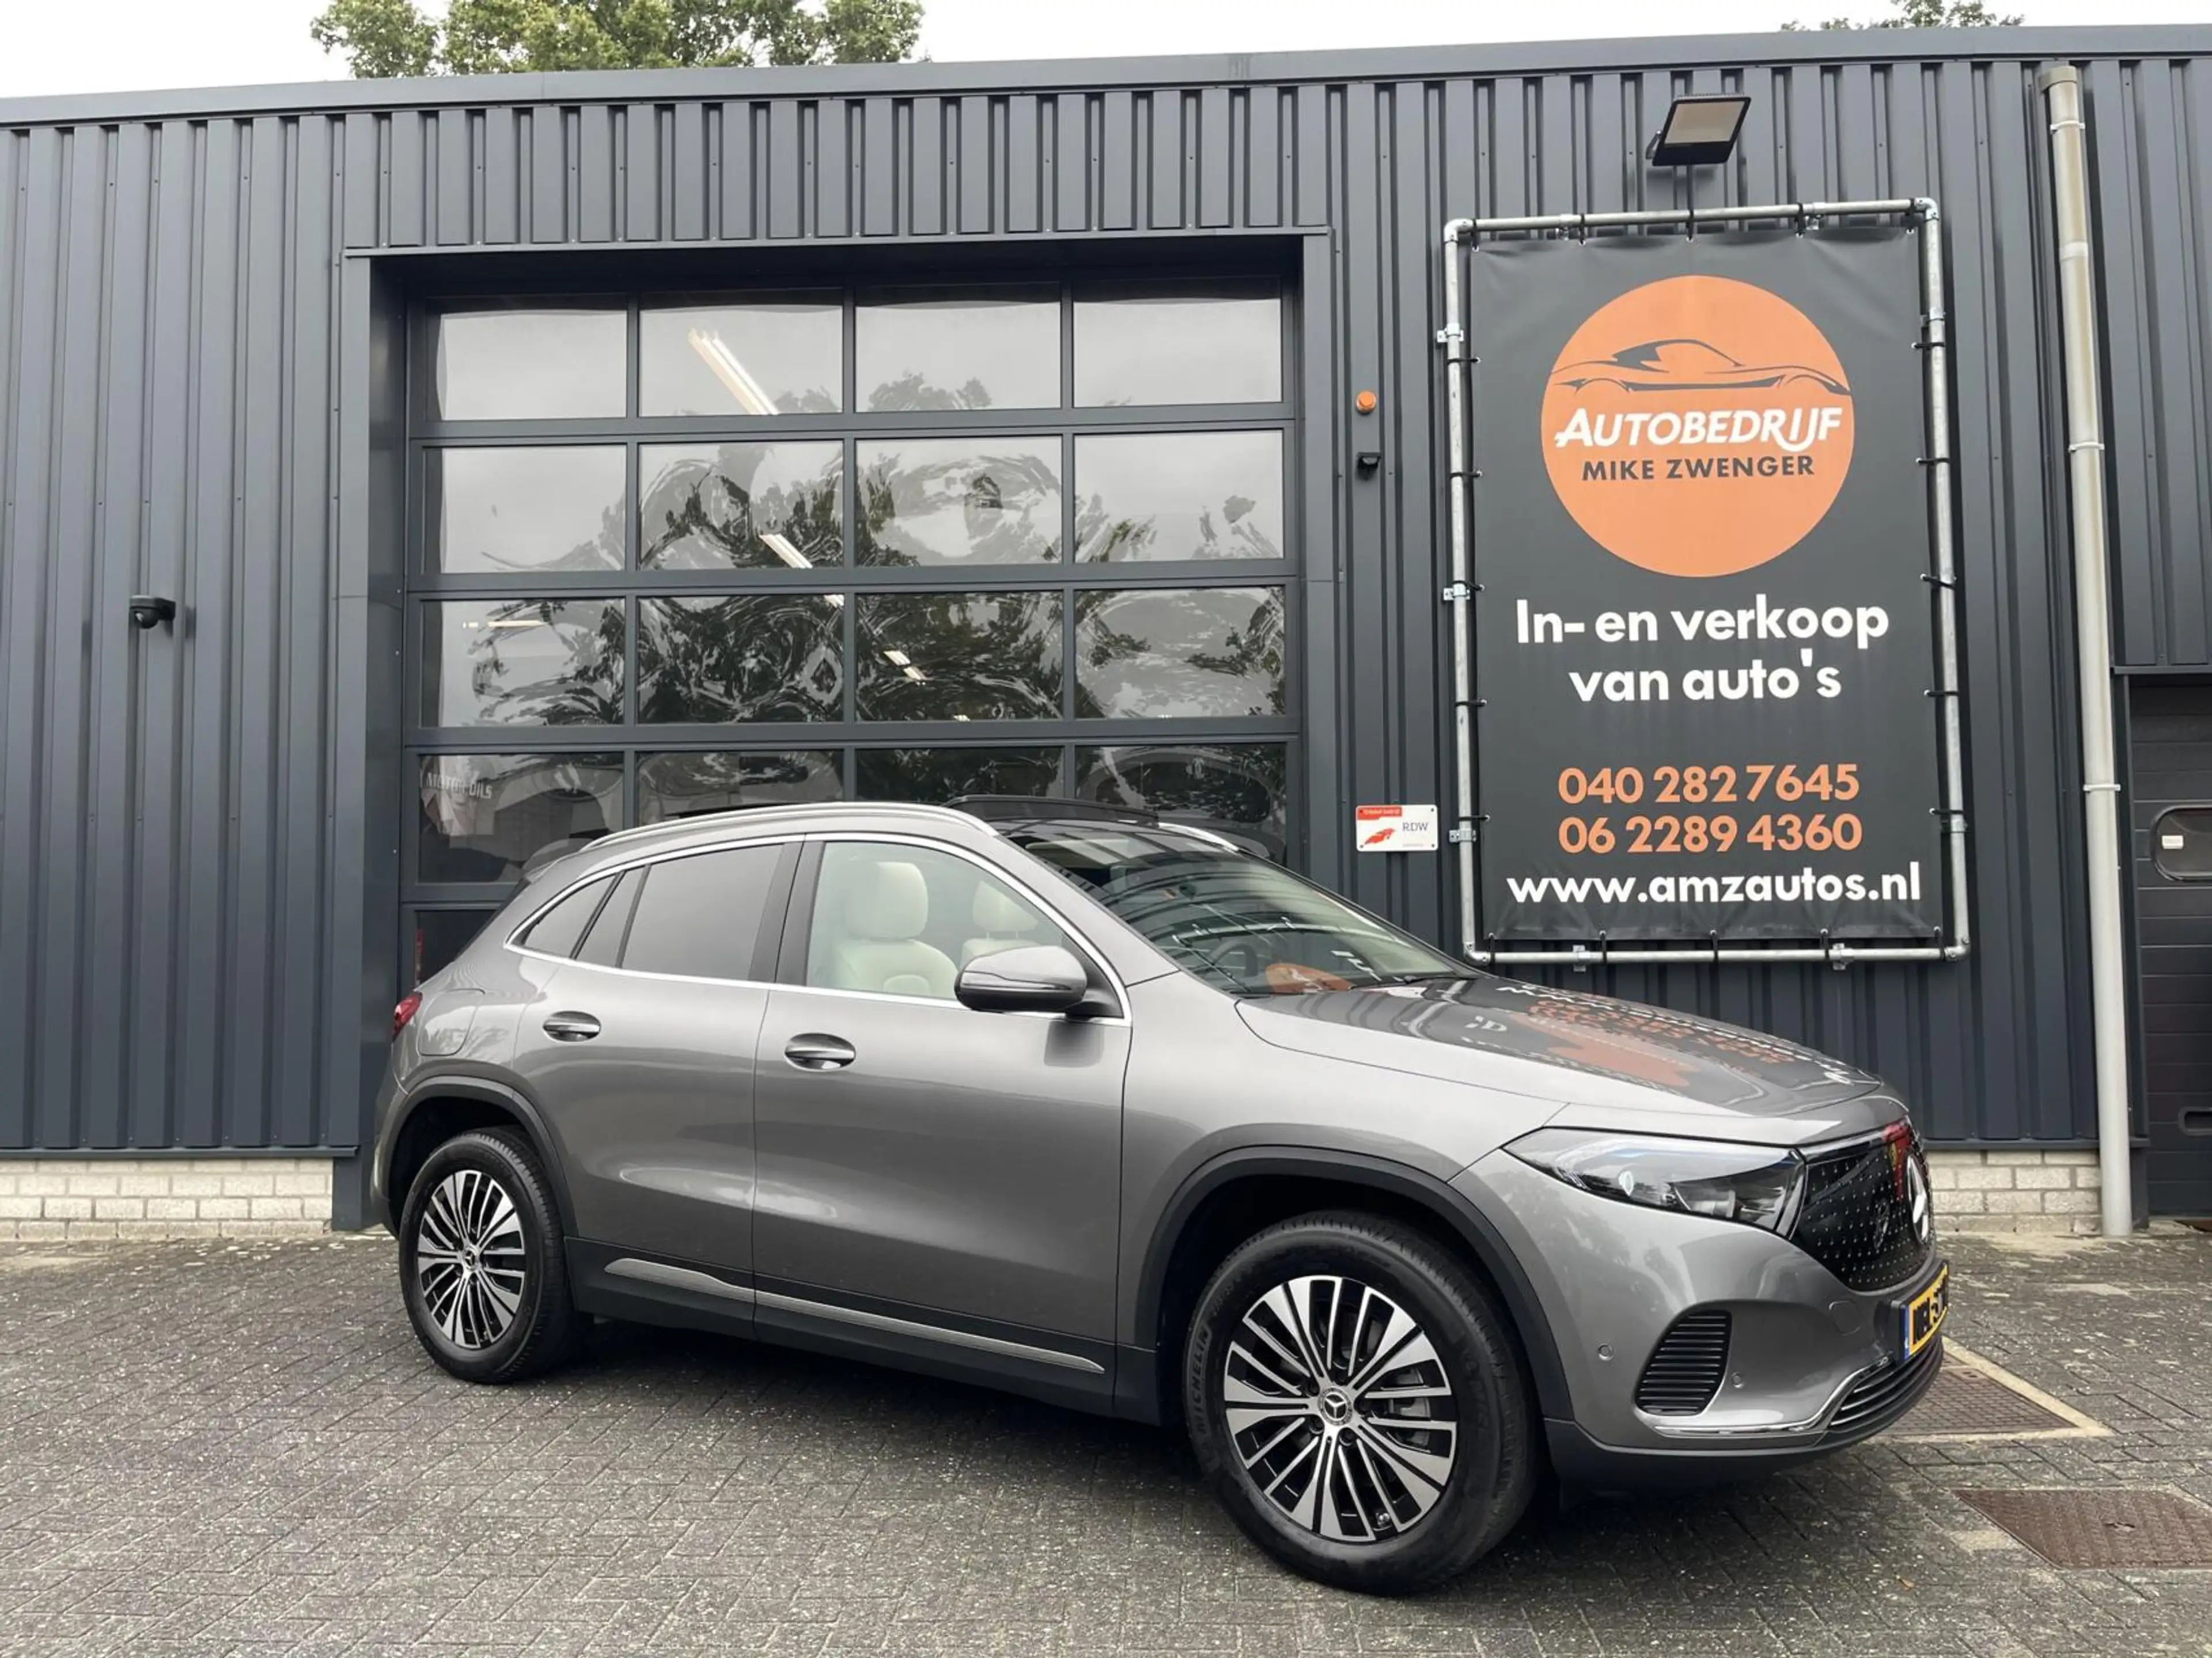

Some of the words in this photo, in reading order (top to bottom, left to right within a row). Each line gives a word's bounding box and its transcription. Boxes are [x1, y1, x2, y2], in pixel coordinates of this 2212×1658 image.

[1554, 407, 1843, 453] AUTOBEDRIJF
[1582, 460, 1654, 481] MIKE
[1666, 455, 1815, 479] ZWENGER
[1517, 599, 1585, 644] In-
[1595, 610, 1658, 643] en
[1670, 593, 1889, 650] verkoop
[1569, 670, 1669, 702] van
[1682, 648, 1842, 701] auto's
[1558, 766, 1645, 805] 040
[1653, 765, 1738, 803] 282
[1745, 763, 1860, 802] 7645
[1402, 822, 1429, 832] RDW
[1558, 816, 1616, 855] 06
[1626, 814, 1738, 853] 2289
[1745, 813, 1863, 852] 4360
[1506, 861, 1921, 904] www.amzautos.nl
[1191, 1325, 1211, 1435] MICHELIN
